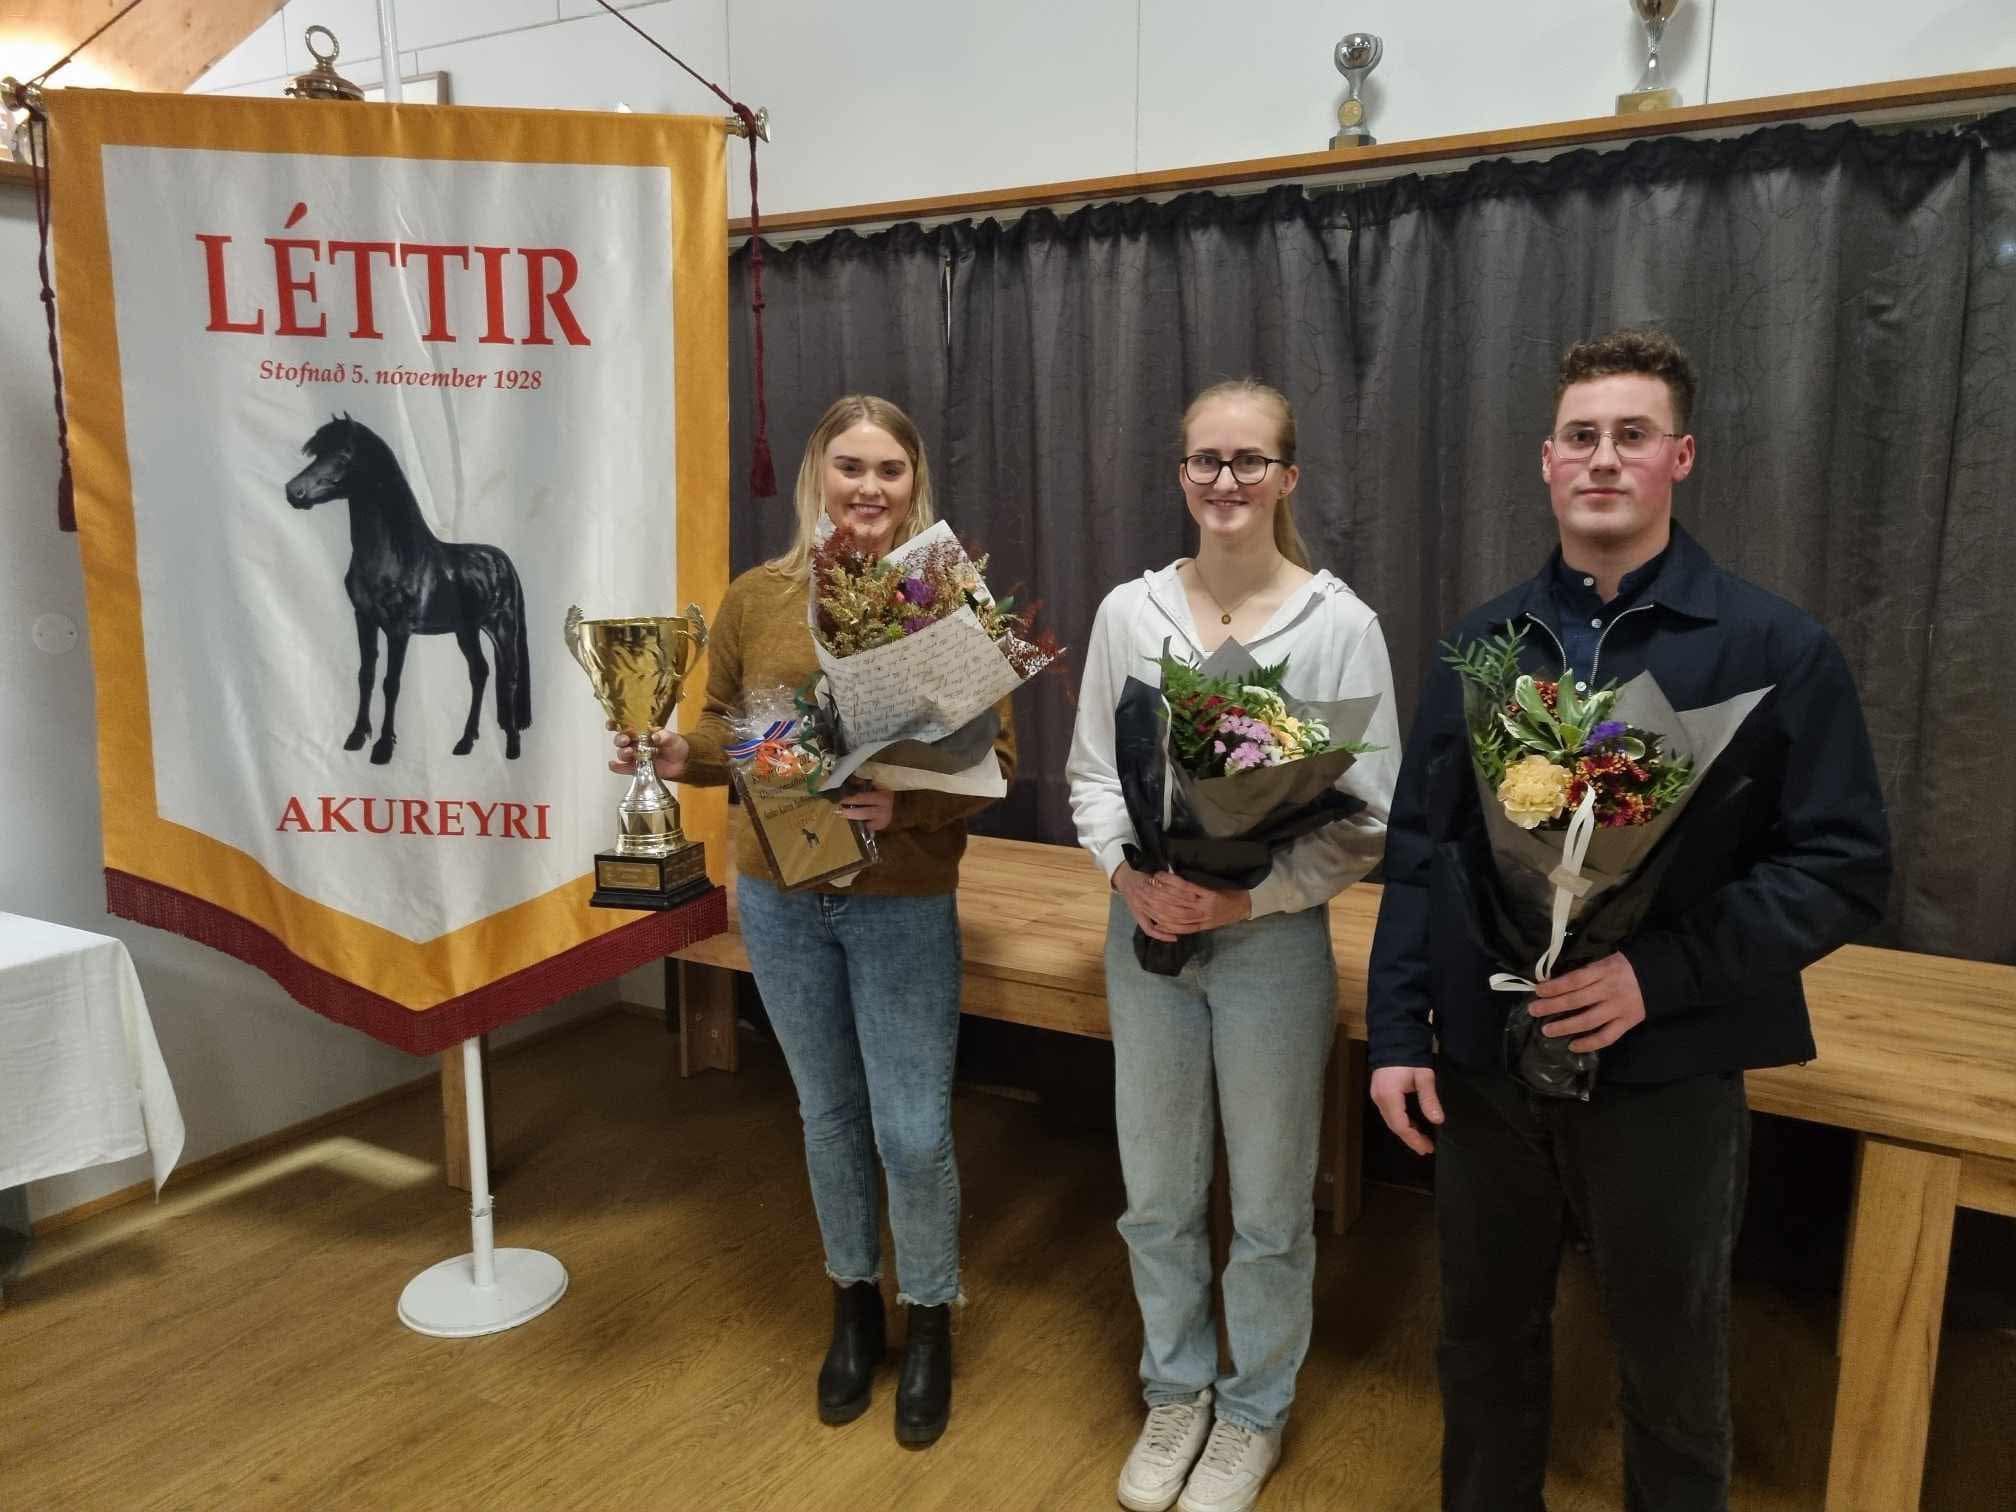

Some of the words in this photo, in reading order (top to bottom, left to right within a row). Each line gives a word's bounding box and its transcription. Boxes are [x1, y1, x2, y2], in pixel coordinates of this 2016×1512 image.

[196, 202, 593, 346] LÉTTIR
[259, 360, 346, 387] Stofnað
[351, 364, 369, 384] 5.
[376, 365, 486, 388] nóvember
[495, 370, 542, 390] 1928
[275, 795, 551, 840] AKUREYRI
